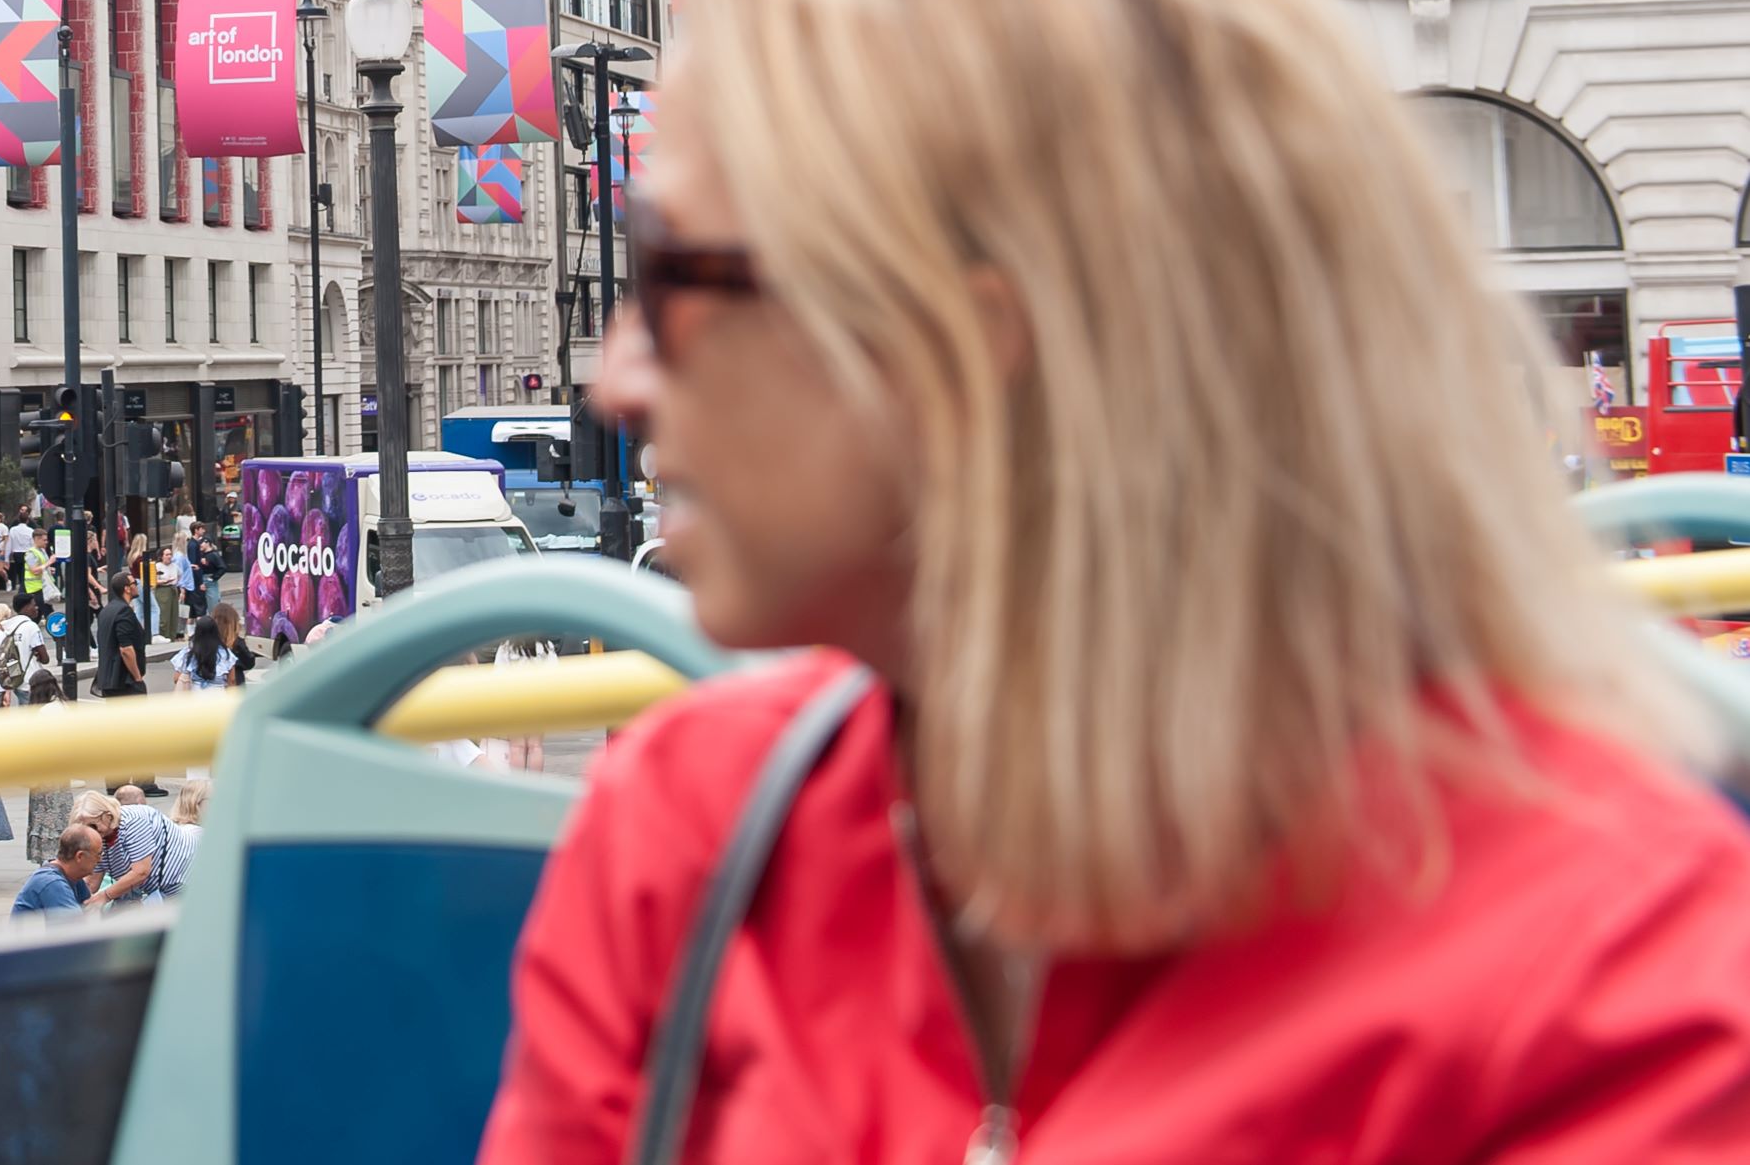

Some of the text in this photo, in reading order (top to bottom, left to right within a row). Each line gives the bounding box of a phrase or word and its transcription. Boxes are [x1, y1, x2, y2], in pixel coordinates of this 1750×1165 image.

[188, 26, 238, 45] art of
[217, 44, 283, 64] london
[276, 536, 335, 576] ocado
